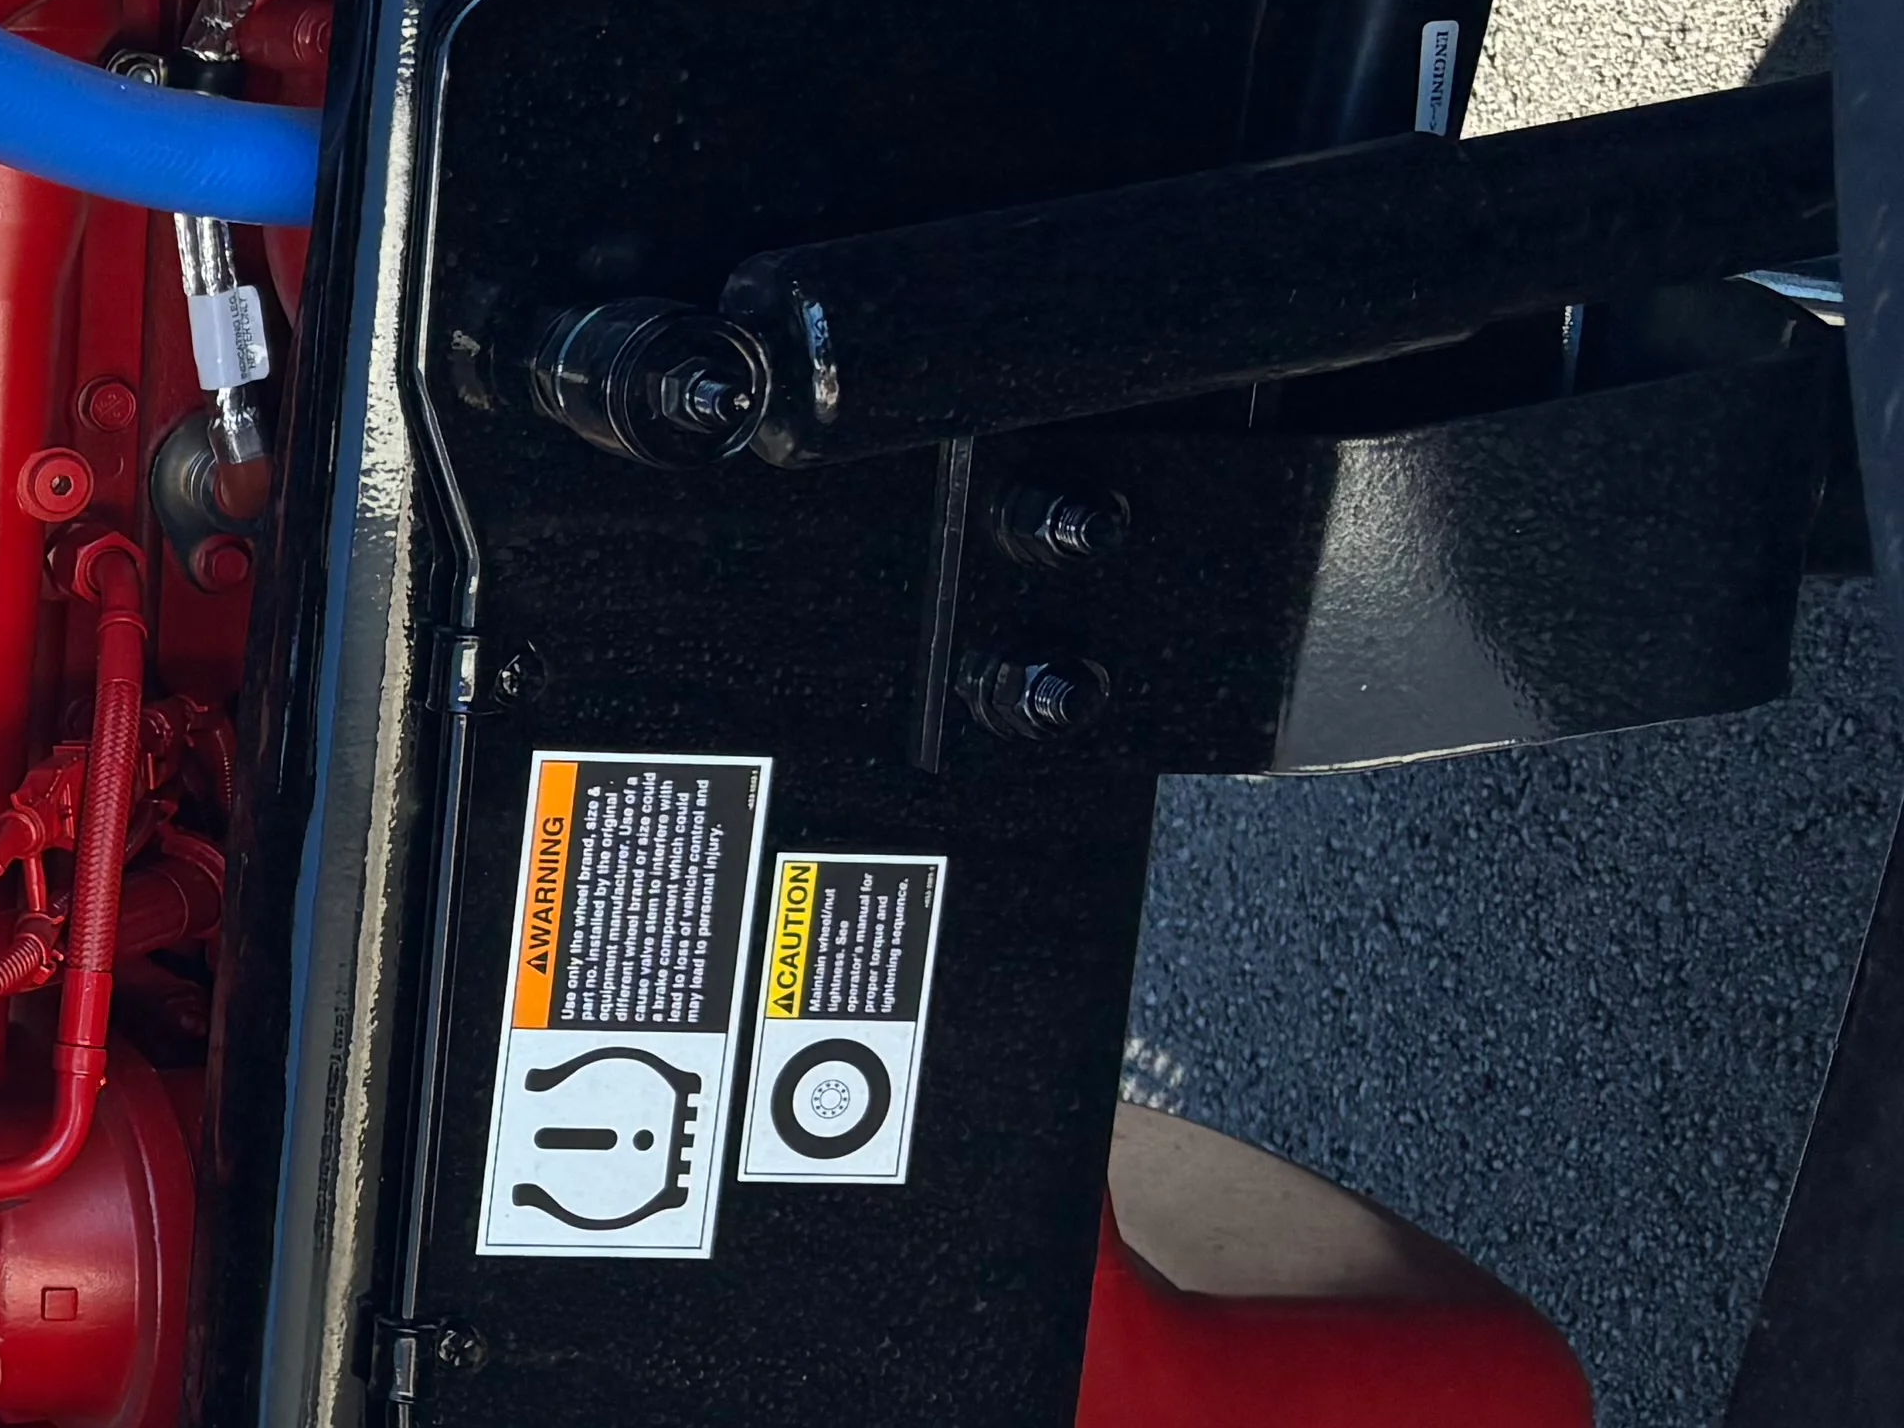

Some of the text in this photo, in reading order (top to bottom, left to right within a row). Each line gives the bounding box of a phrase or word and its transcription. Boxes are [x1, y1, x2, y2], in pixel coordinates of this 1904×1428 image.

[1429, 30, 1448, 108] ENGINE
[239, 297, 256, 368] HEATER ONLY
[528, 814, 564, 951] WARNING
[560, 785, 601, 1020] Use only the wheel brand, size &
[579, 791, 620, 1021] part no. installed by the original
[598, 775, 638, 1021] equipment manufacturer. Use of a
[615, 770, 656, 1021] different wheel brand or size could
[634, 778, 673, 1022] cause valve stem to interfere with
[651, 791, 690, 1022] a brake component which could
[667, 778, 709, 1023] lead to loss of vehicle control and
[687, 822, 724, 1023] may lead to personal injury.
[775, 863, 811, 990] CAUTION
[808, 887, 836, 1012] Maintain wheel/nut
[846, 872, 874, 1012] operator's manual for
[880, 876, 910, 1013] tightening sequence.
[827, 919, 849, 1012] tightness. See
[863, 894, 888, 1013] proper torque and
